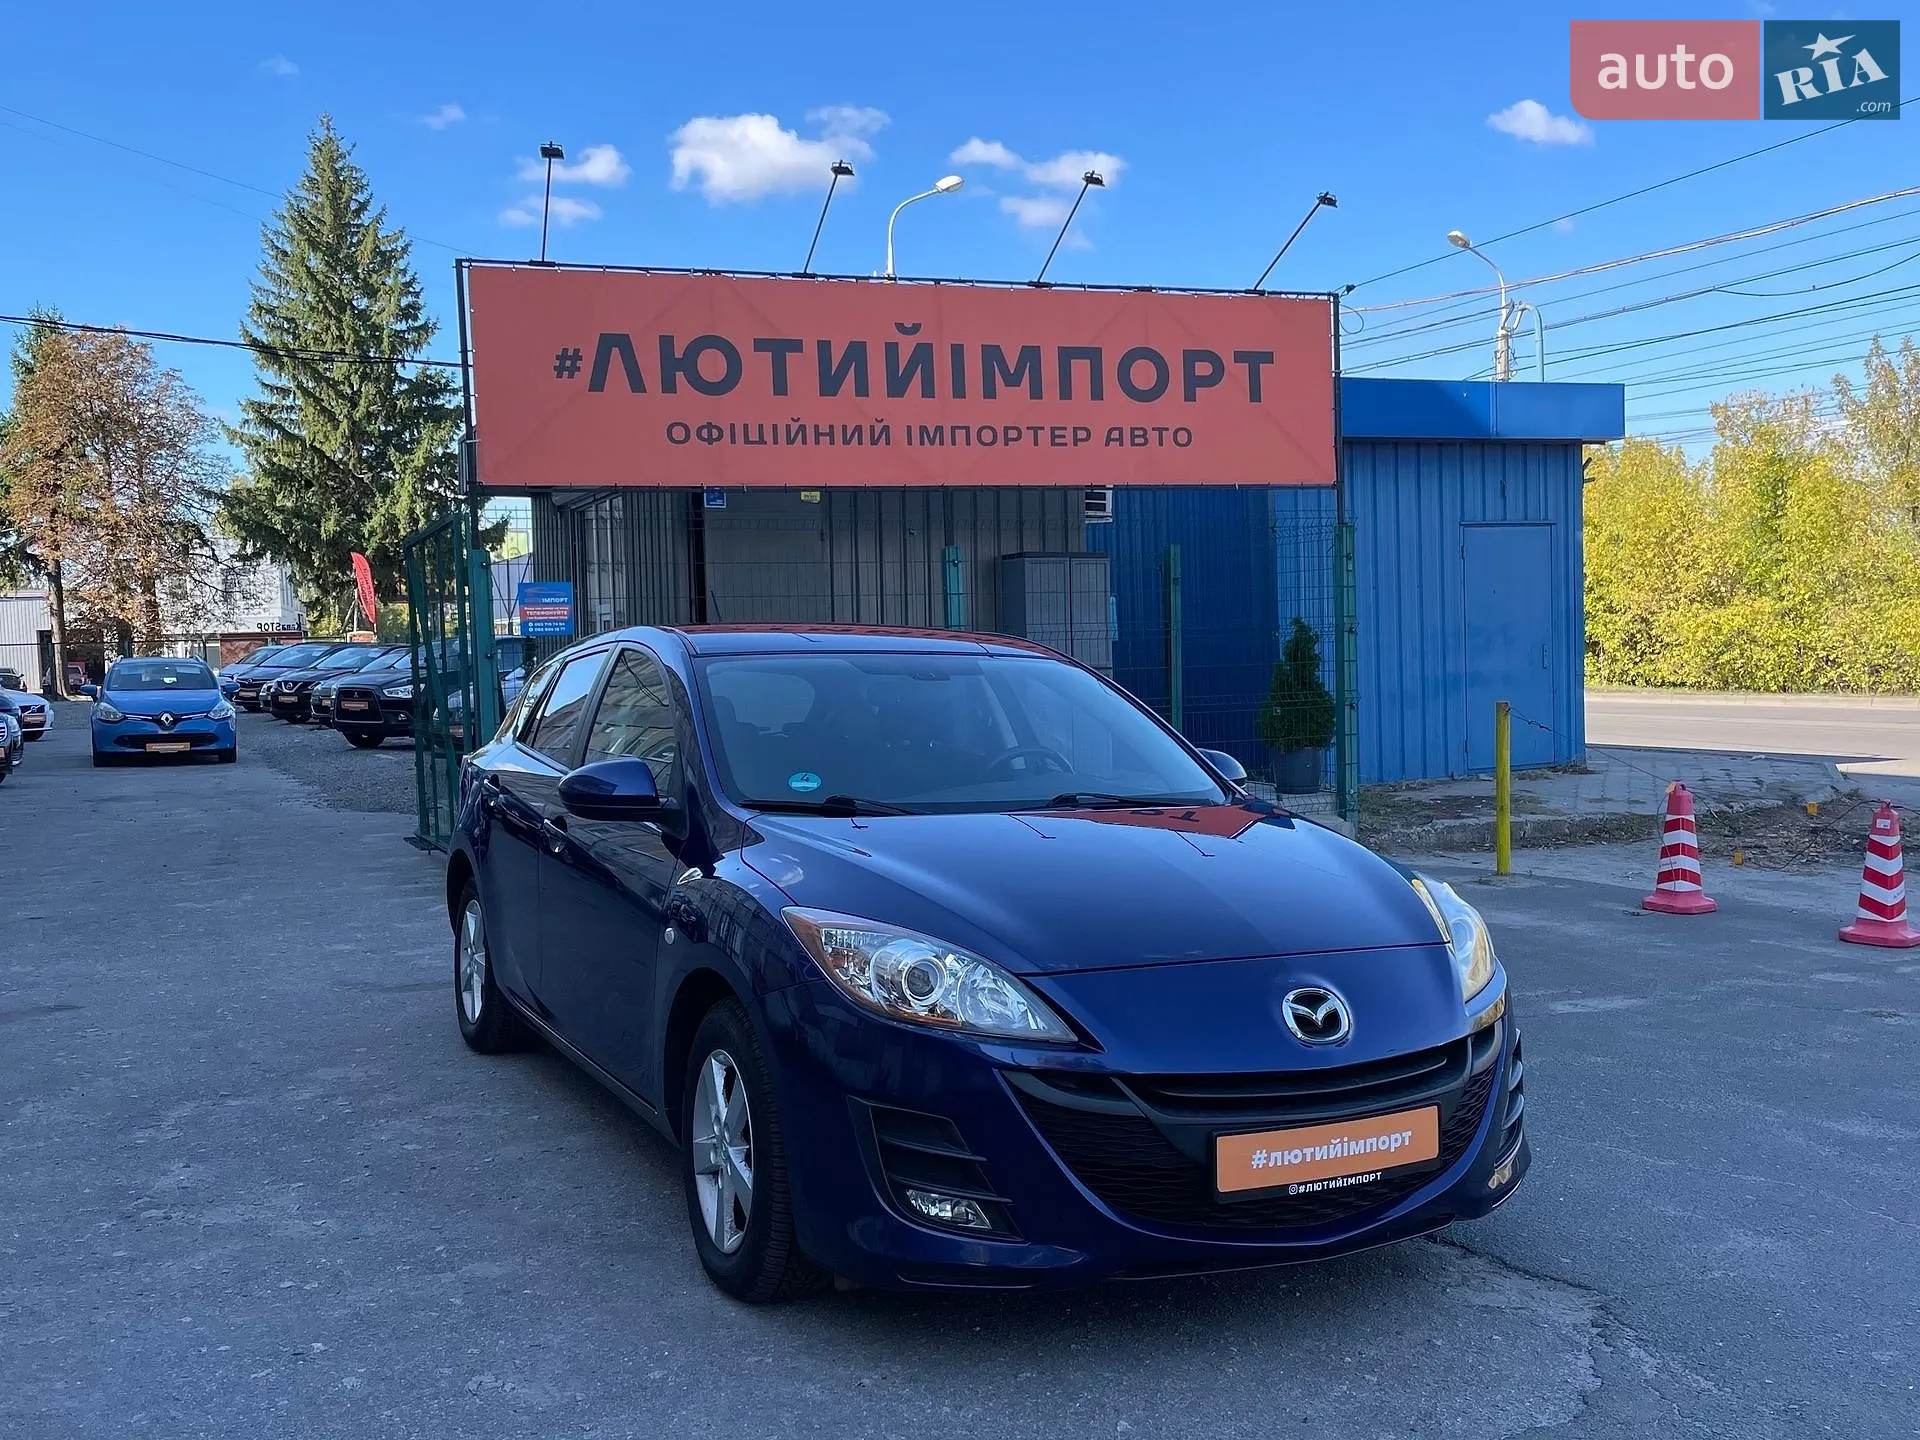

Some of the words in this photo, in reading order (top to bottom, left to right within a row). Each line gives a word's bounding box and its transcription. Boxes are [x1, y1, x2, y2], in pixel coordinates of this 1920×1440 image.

[553, 322, 1275, 404] #ЛЮТИЙІМПОРТ
[666, 417, 892, 447] ОФІЦІЙНИЙ
[906, 425, 1092, 448] ІМПОРТЕР
[1105, 427, 1193, 448] АВТО
[1252, 1131, 1412, 1169] #лютийімпорт
